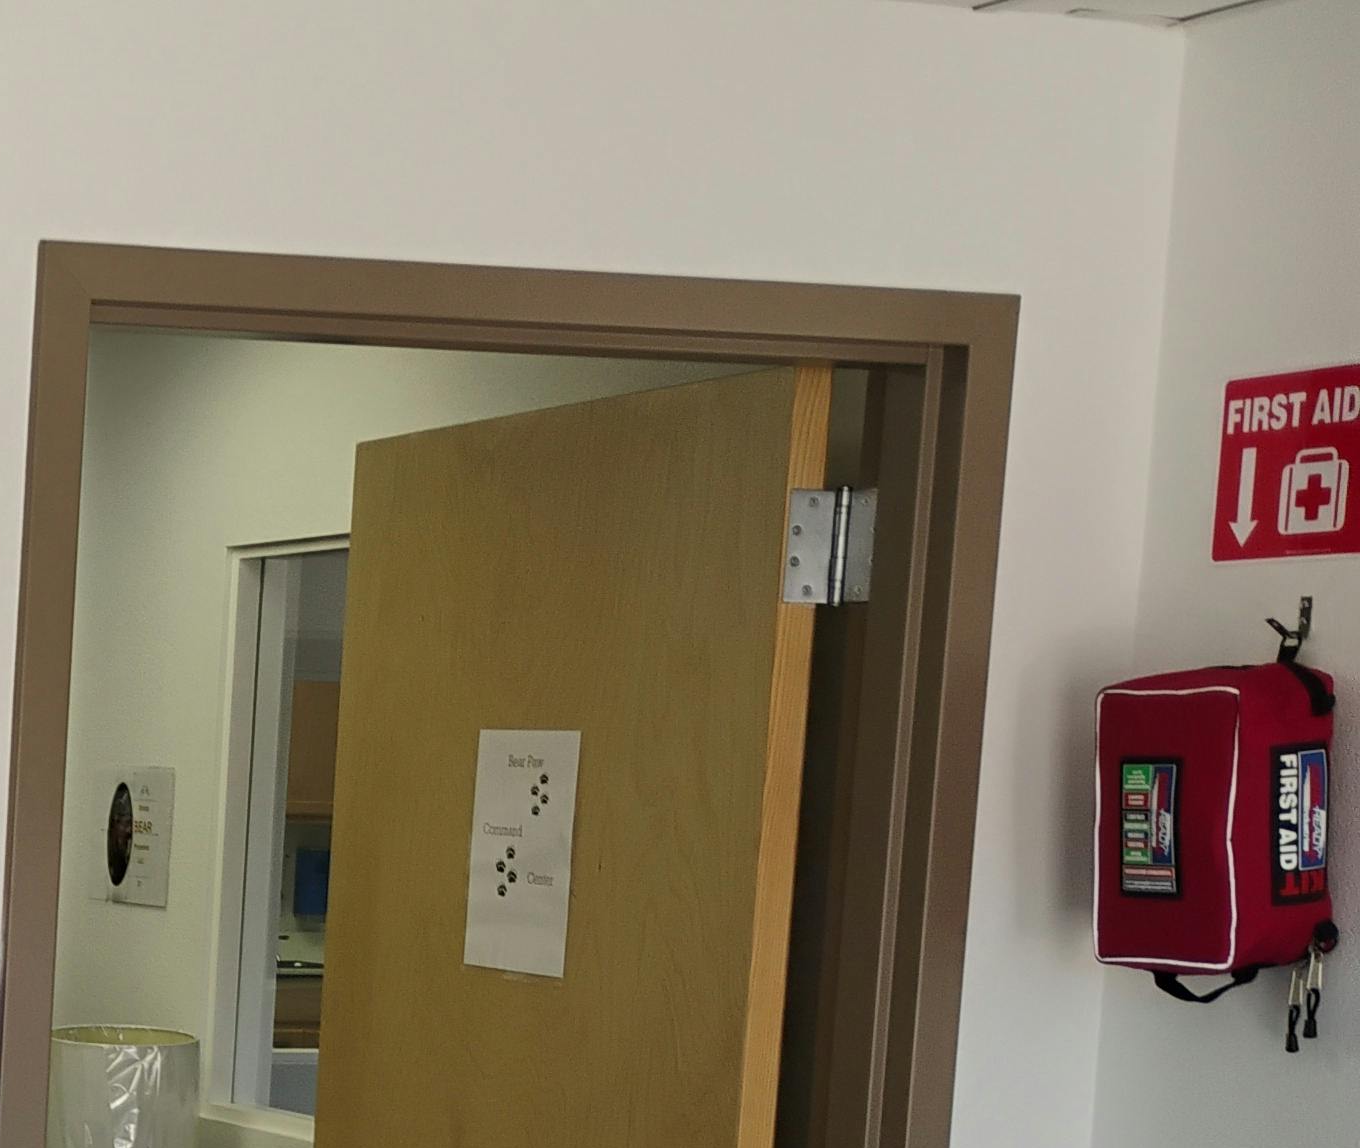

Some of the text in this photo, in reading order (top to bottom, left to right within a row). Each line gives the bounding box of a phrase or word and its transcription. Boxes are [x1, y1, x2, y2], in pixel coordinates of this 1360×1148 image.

[1226, 385, 1360, 435] FIRST AID
[508, 754, 544, 768] Bear Paw
[1278, 753, 1298, 871] FIRST AID
[483, 822, 523, 837] Command
[527, 872, 553, 887] Center
